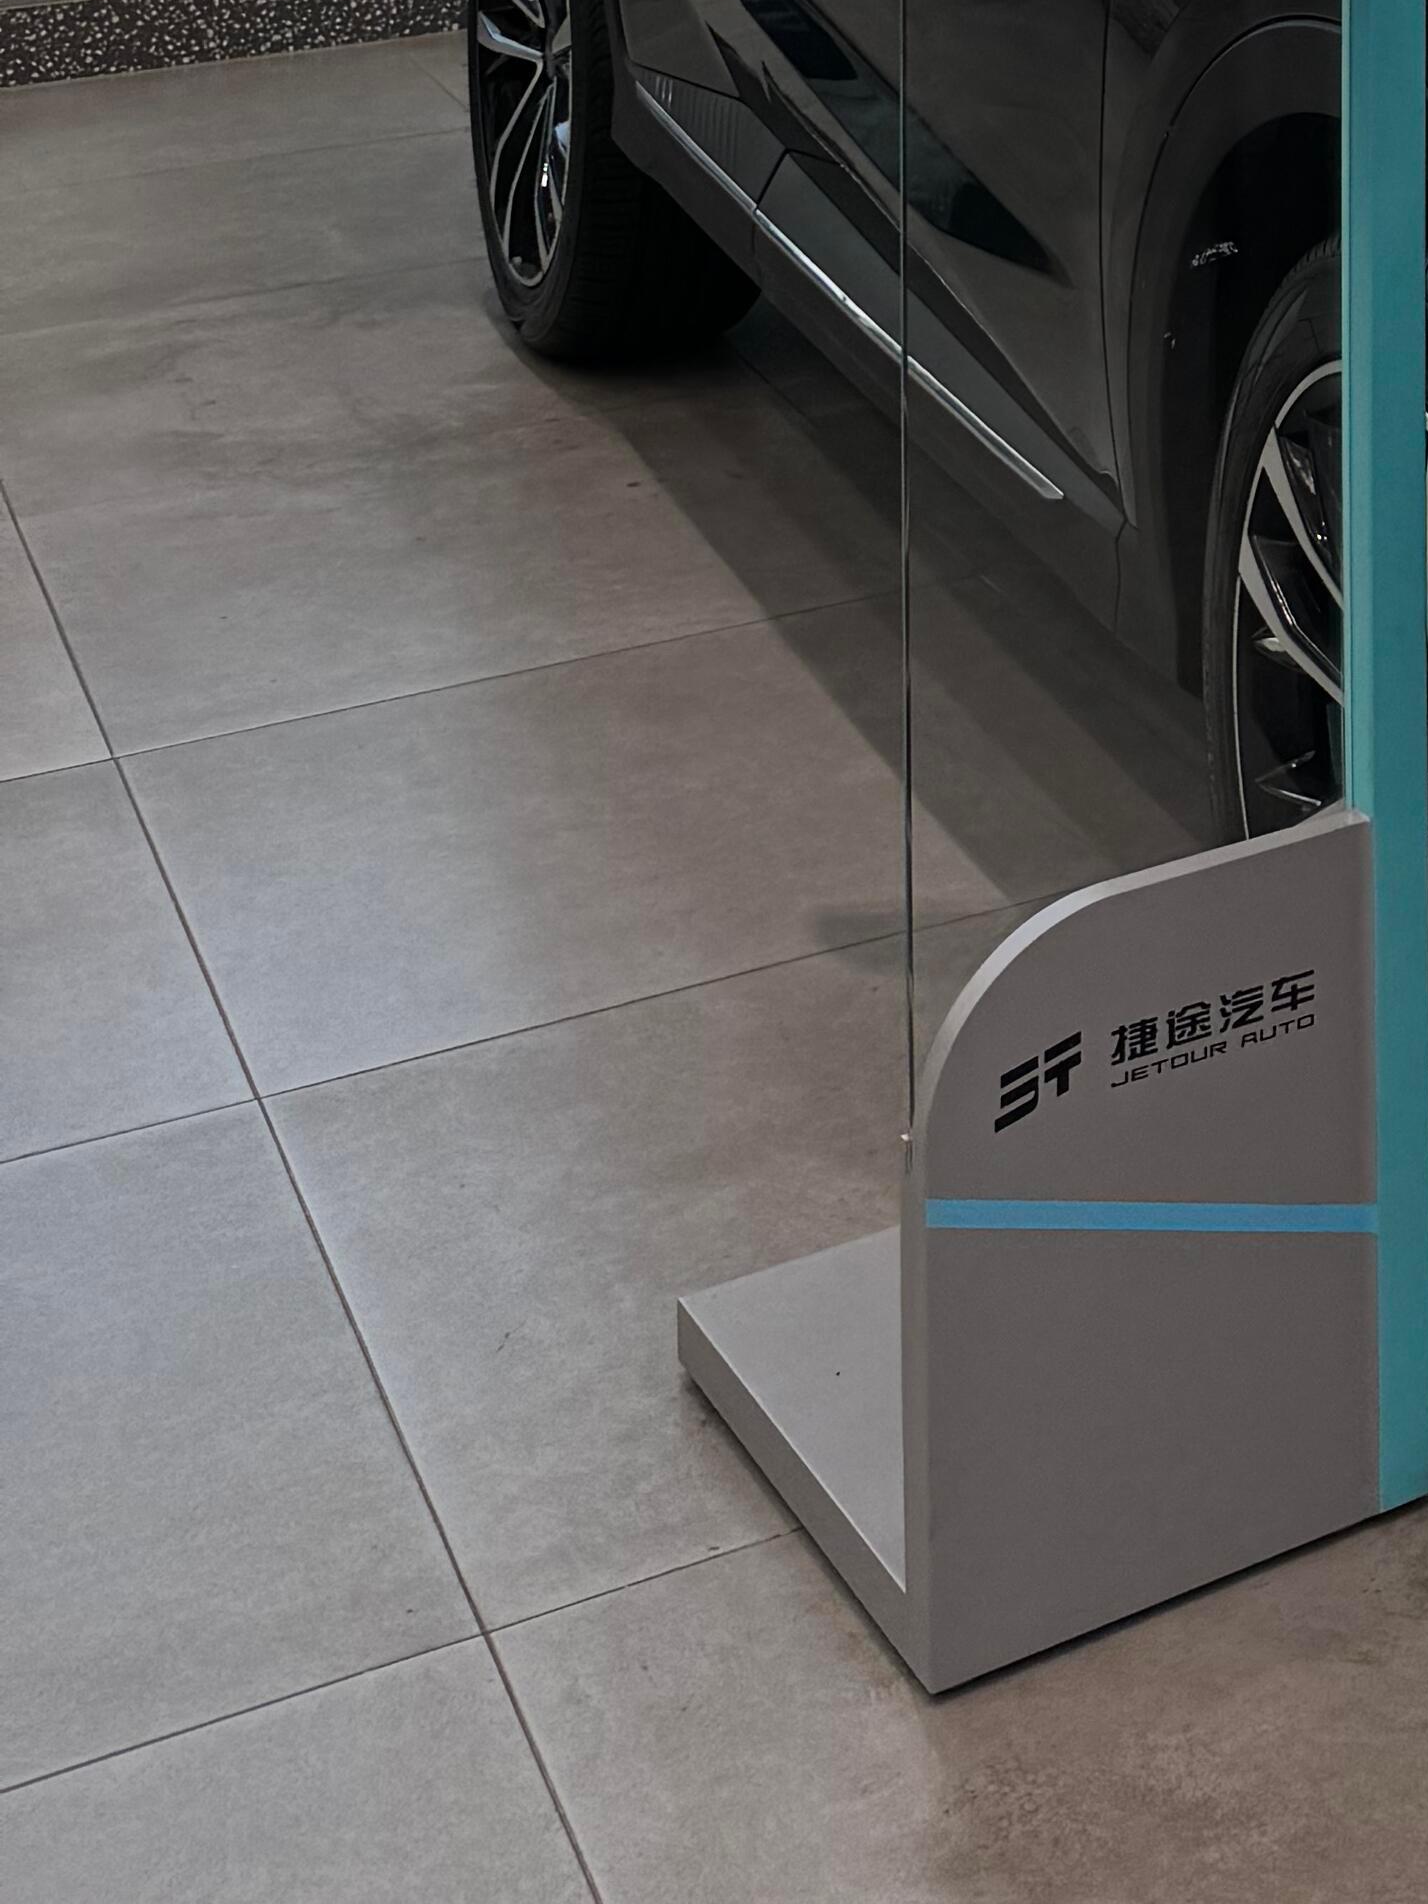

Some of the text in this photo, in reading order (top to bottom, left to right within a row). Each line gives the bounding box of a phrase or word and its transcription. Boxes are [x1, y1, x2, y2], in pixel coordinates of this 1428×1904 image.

[1110, 968, 1315, 1067] 捷途汽车
[1110, 1013, 1316, 1088] JETOUR AUTO
